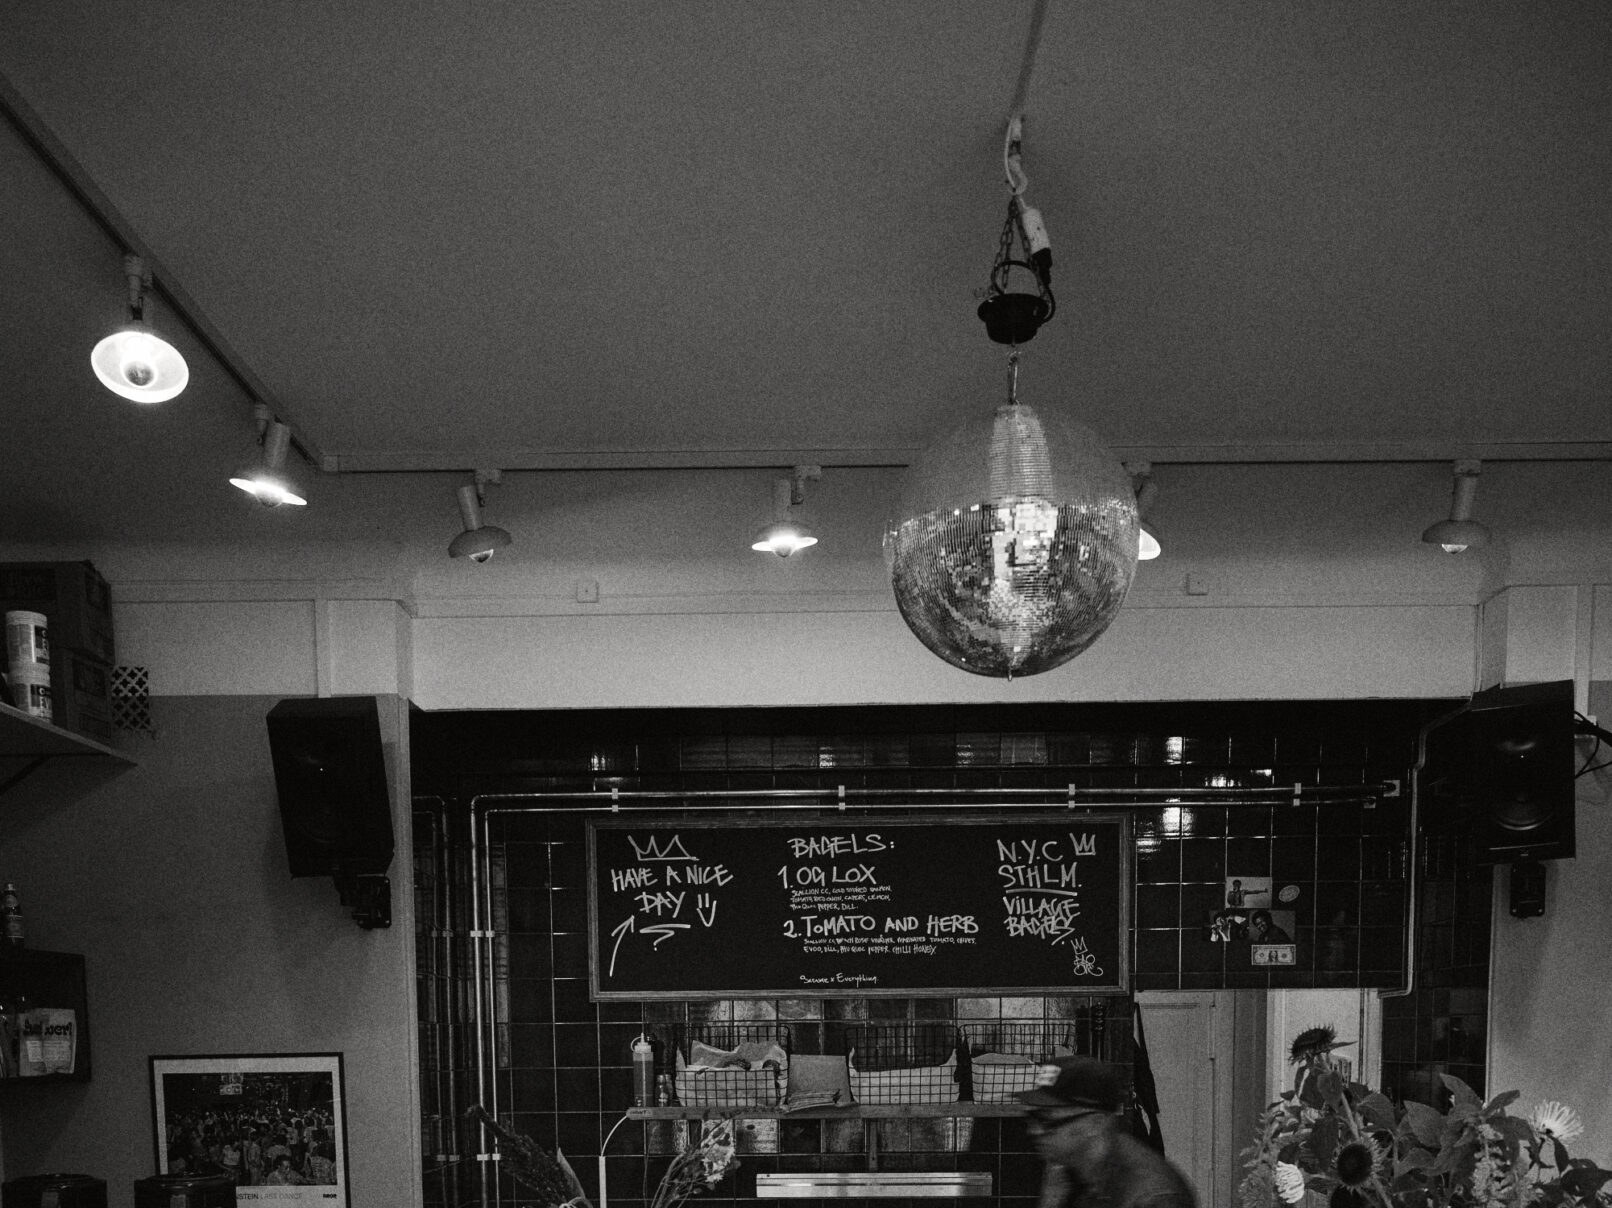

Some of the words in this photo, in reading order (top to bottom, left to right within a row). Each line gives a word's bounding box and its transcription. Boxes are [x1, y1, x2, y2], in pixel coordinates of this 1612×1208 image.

[787, 834, 894, 858] BAGELS:
[611, 868, 658, 892] HAVE
[666, 865, 682, 886] A
[686, 864, 734, 886] NICE
[832, 864, 876, 884] LOX
[998, 862, 1082, 888] STHLM.
[634, 891, 686, 918] DAY
[885, 916, 919, 933] AND
[927, 915, 979, 937] HERB
